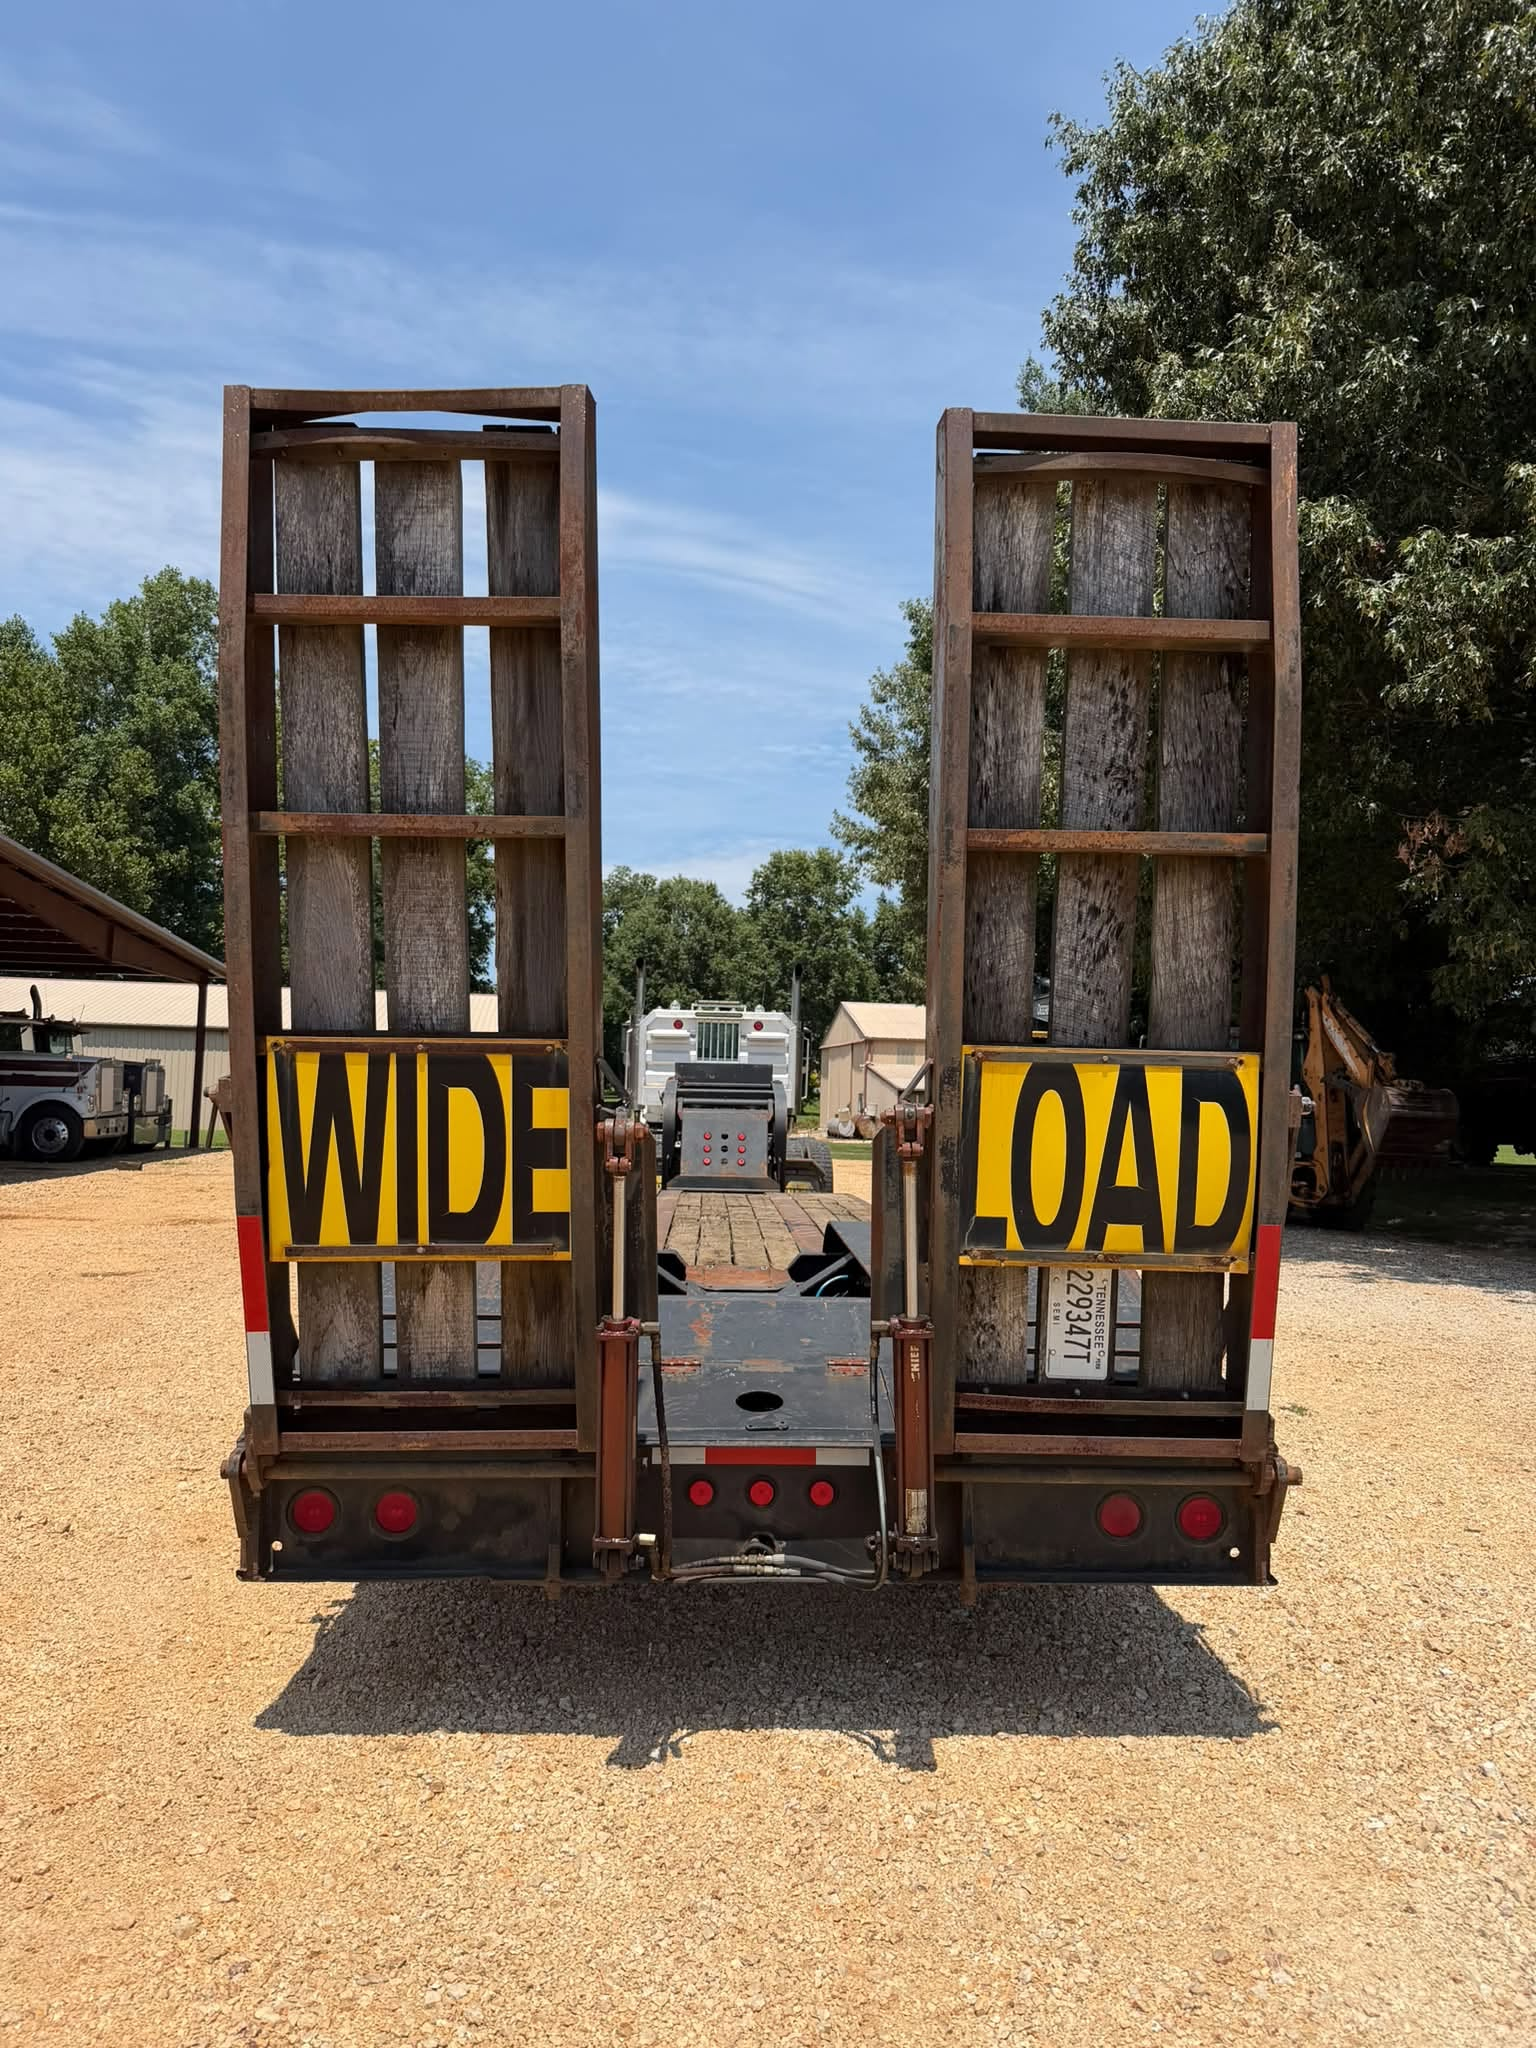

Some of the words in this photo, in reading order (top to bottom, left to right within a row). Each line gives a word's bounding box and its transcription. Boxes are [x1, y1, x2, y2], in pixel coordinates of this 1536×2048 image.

[273, 1052, 571, 1246] WIDE
[961, 1062, 1251, 1254] LOAD
[1053, 1303, 1061, 1325] SEMI
[1063, 1269, 1094, 1364] 229347T
[1094, 1286, 1106, 1349] TENNESSEE
